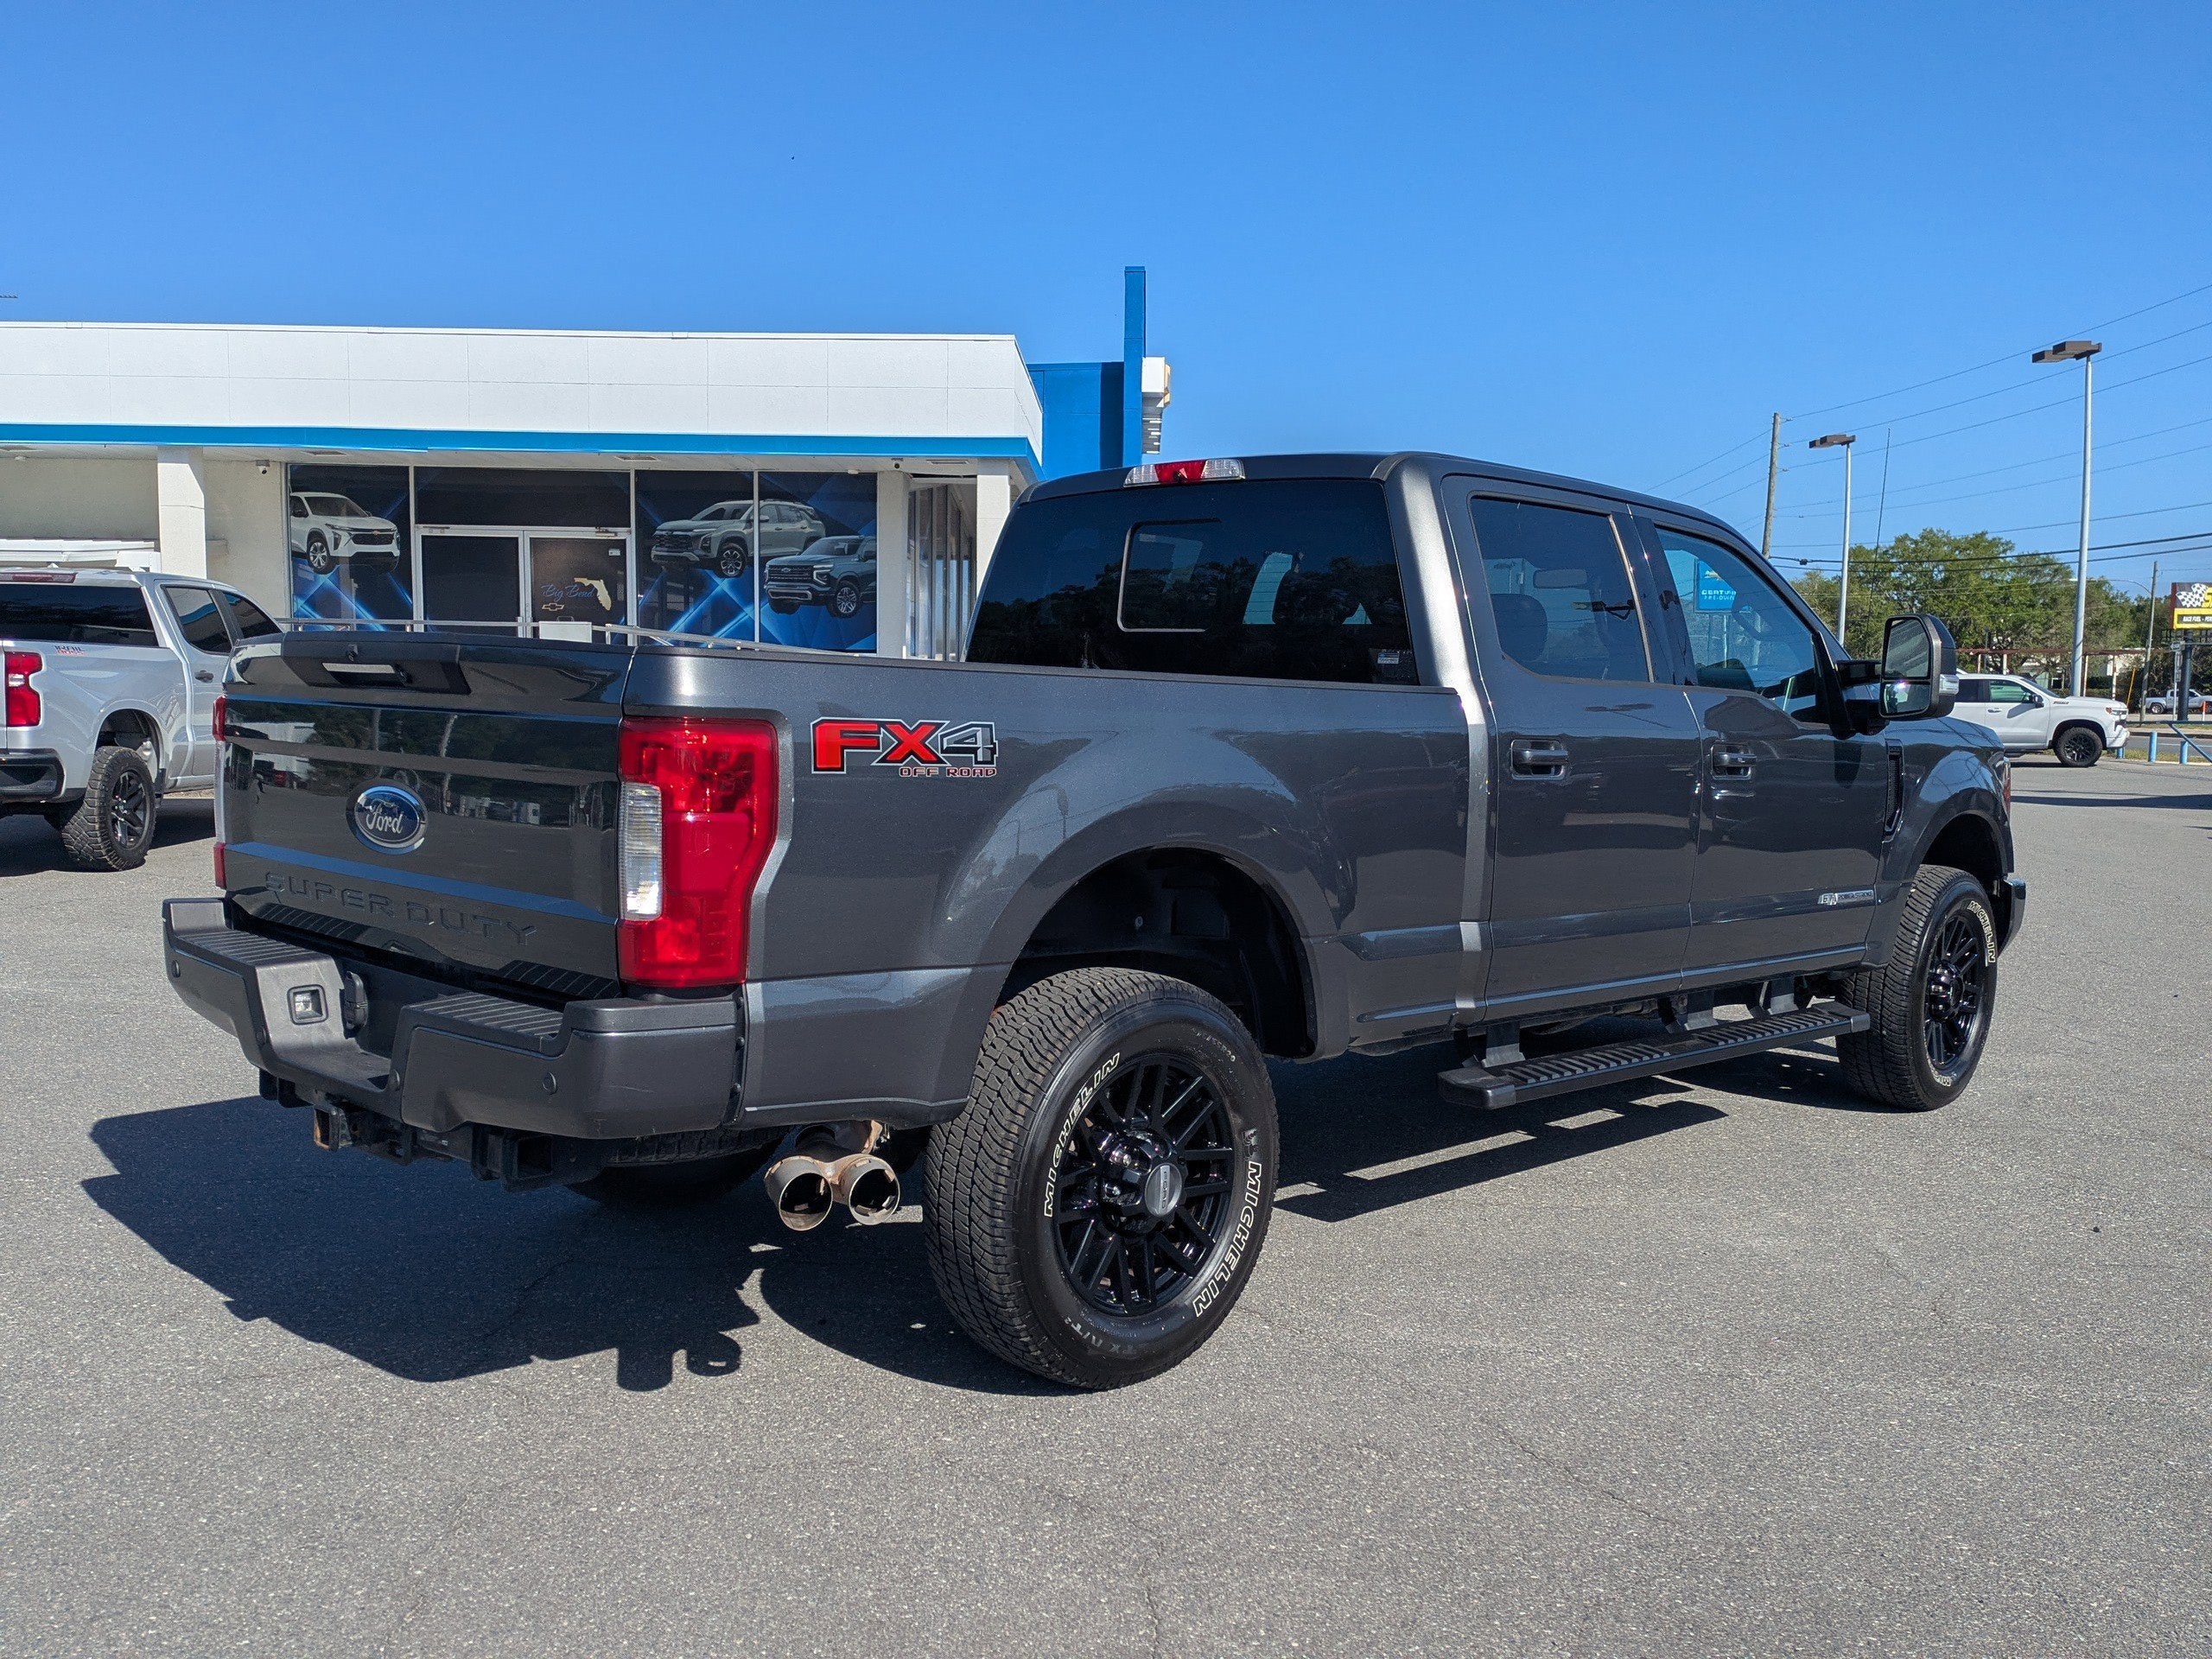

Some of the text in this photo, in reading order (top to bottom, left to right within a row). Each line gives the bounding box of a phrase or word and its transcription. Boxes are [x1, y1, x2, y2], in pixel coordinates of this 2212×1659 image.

[541, 584, 595, 603] Big Bend
[810, 716, 999, 774] FX4
[899, 766, 996, 779] OFF ROAD
[365, 798, 404, 834] Ford
[264, 871, 538, 947] SUPER DUTY
[1967, 900, 1997, 963] MICHELIN
[1044, 1052, 1121, 1218] MICHELIN
[1192, 1160, 1262, 1318] MICHELIN
